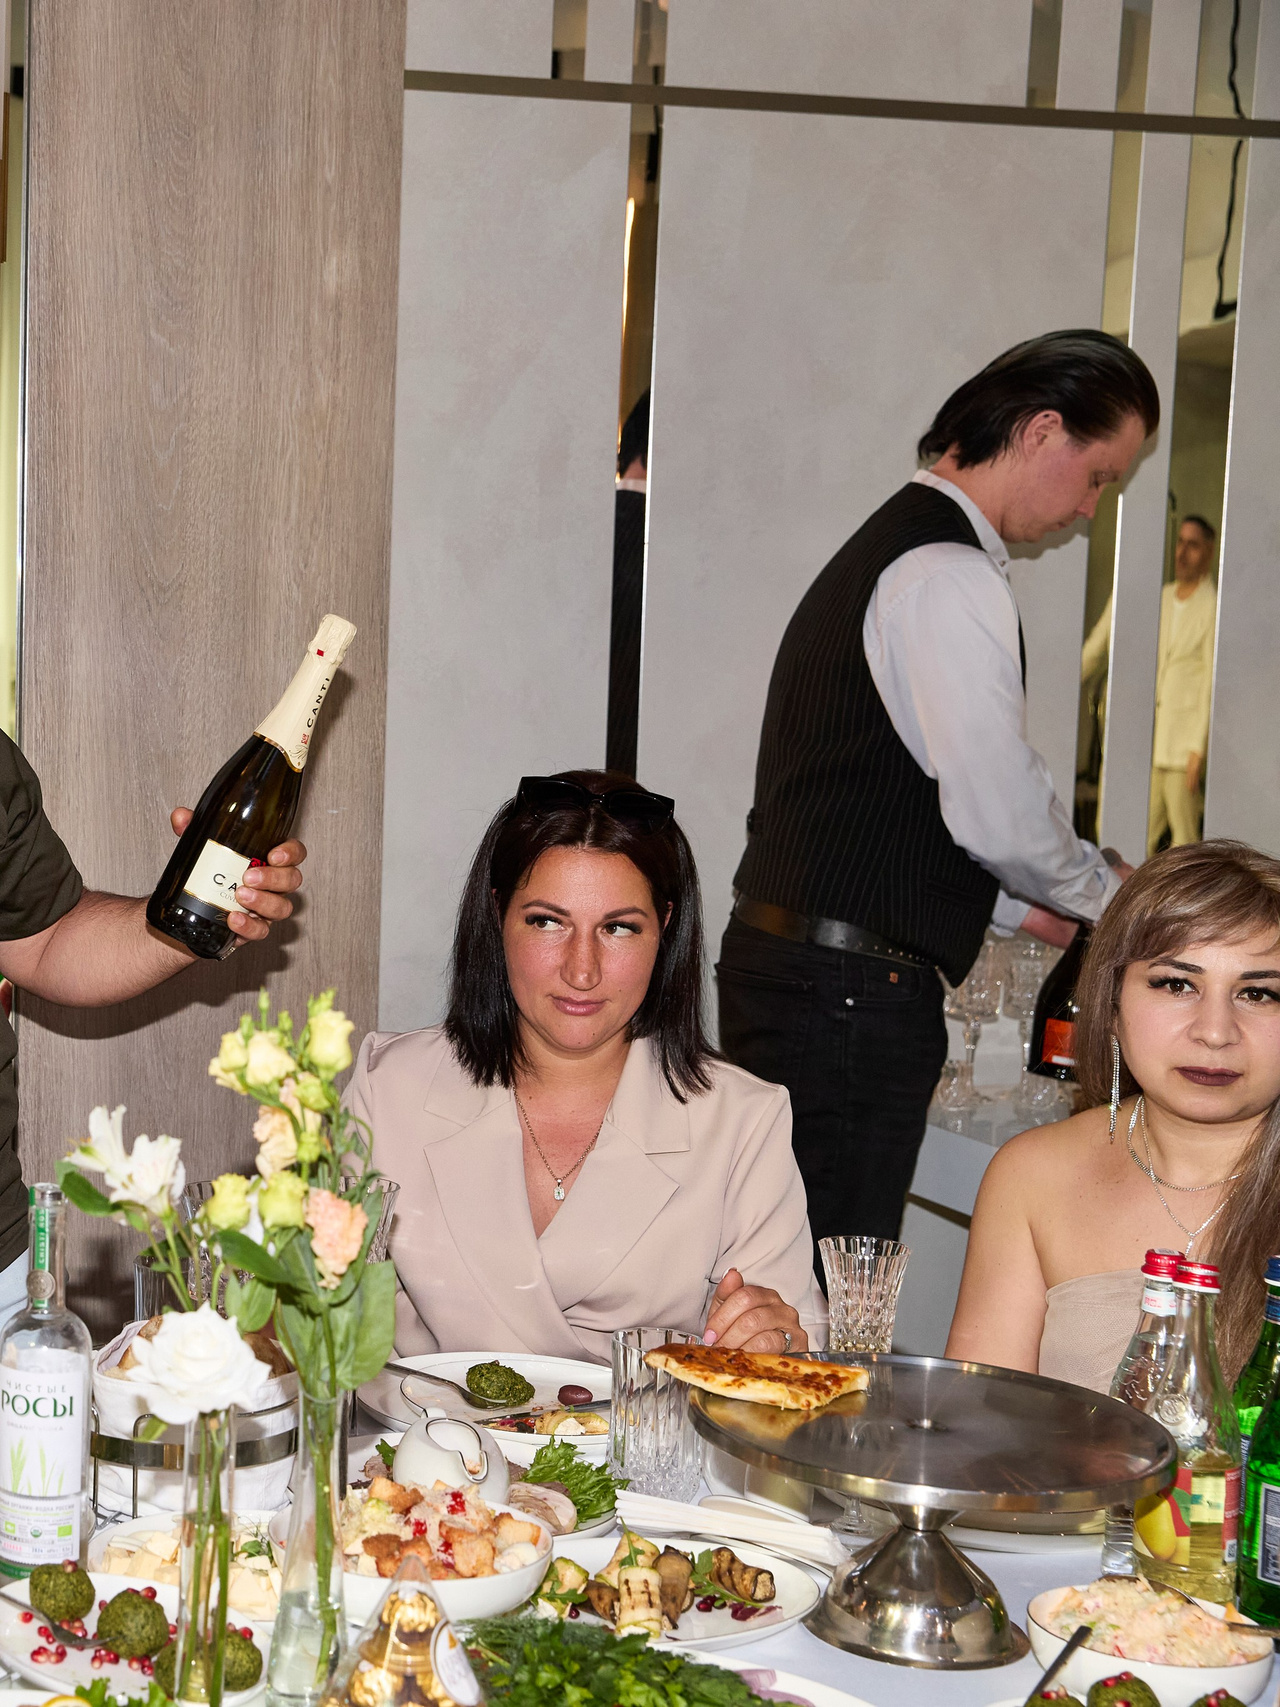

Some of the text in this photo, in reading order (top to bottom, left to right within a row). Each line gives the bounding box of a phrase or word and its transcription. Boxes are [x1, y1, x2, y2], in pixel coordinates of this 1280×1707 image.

[306, 677, 330, 728] CANTI
[213, 873, 238, 892] CA
[6, 1380, 66, 1393] ЧИСТЫЕ
[1, 1389, 74, 1418] РОСЫ
